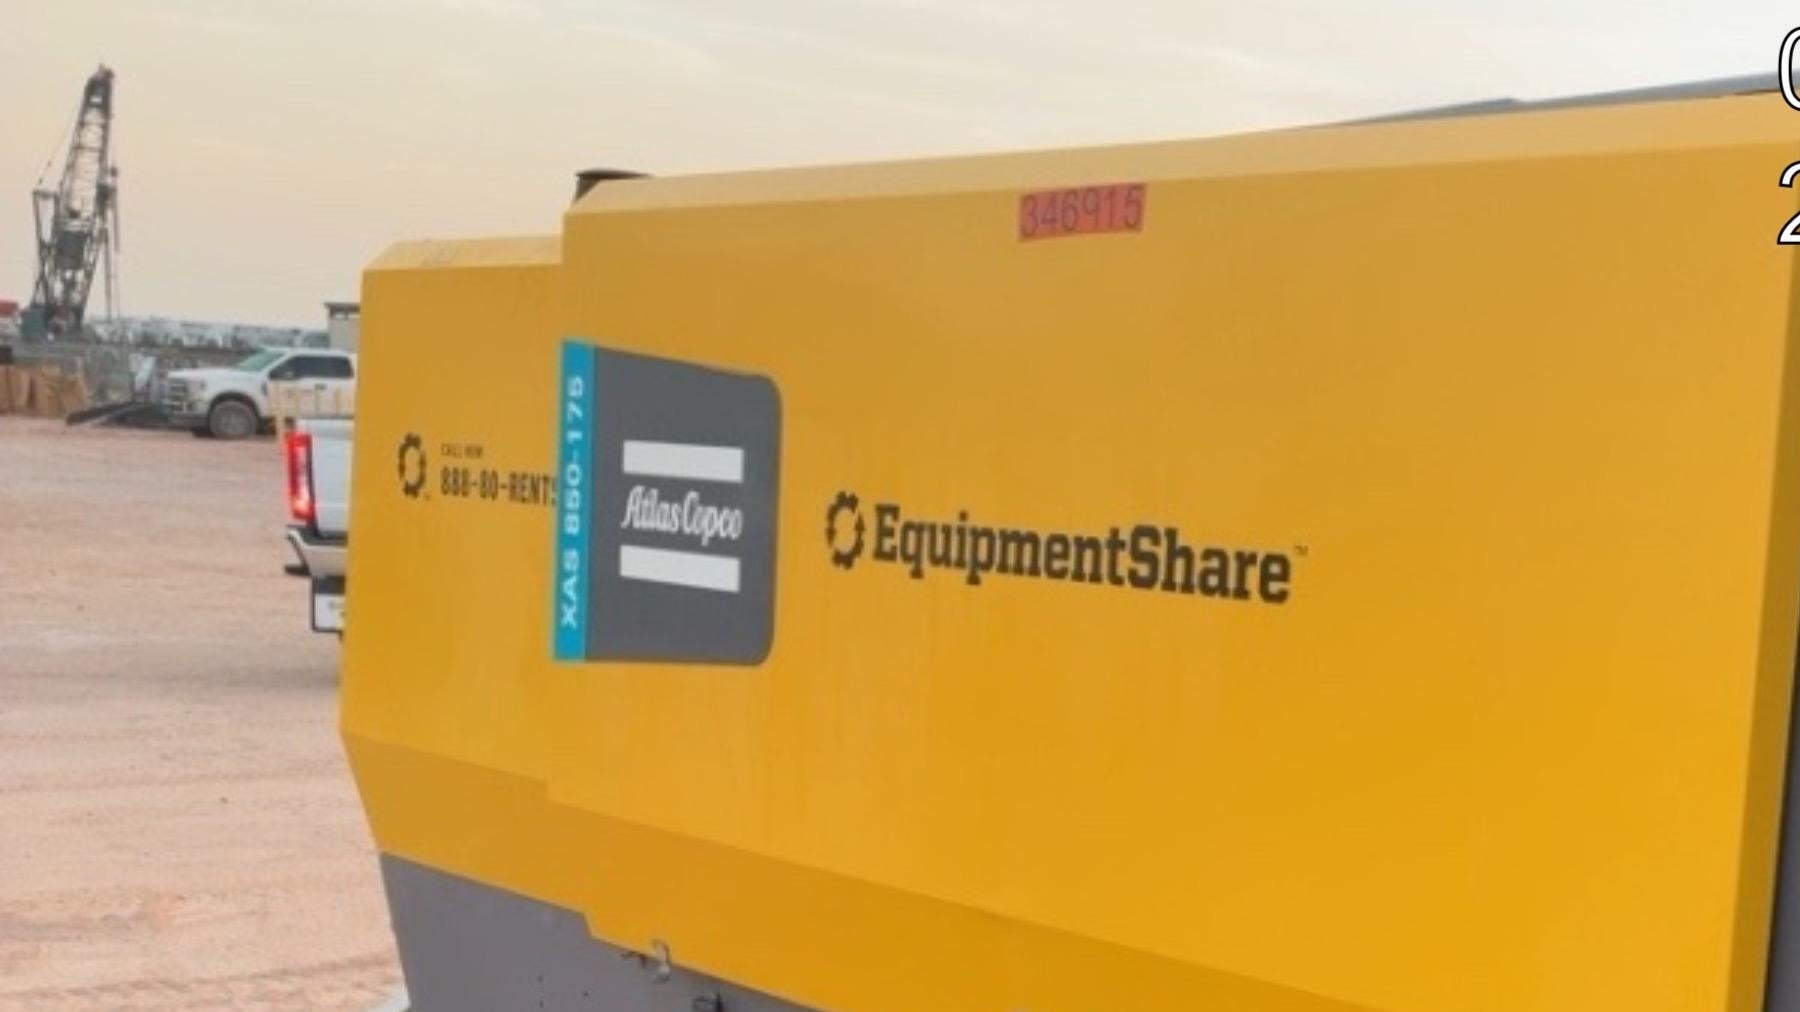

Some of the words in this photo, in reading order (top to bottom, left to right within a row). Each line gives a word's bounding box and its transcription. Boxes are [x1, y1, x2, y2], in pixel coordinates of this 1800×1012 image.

[1020, 183, 1145, 237] 346915
[564, 376, 585, 536] 850-175
[560, 547, 581, 628] XAS
